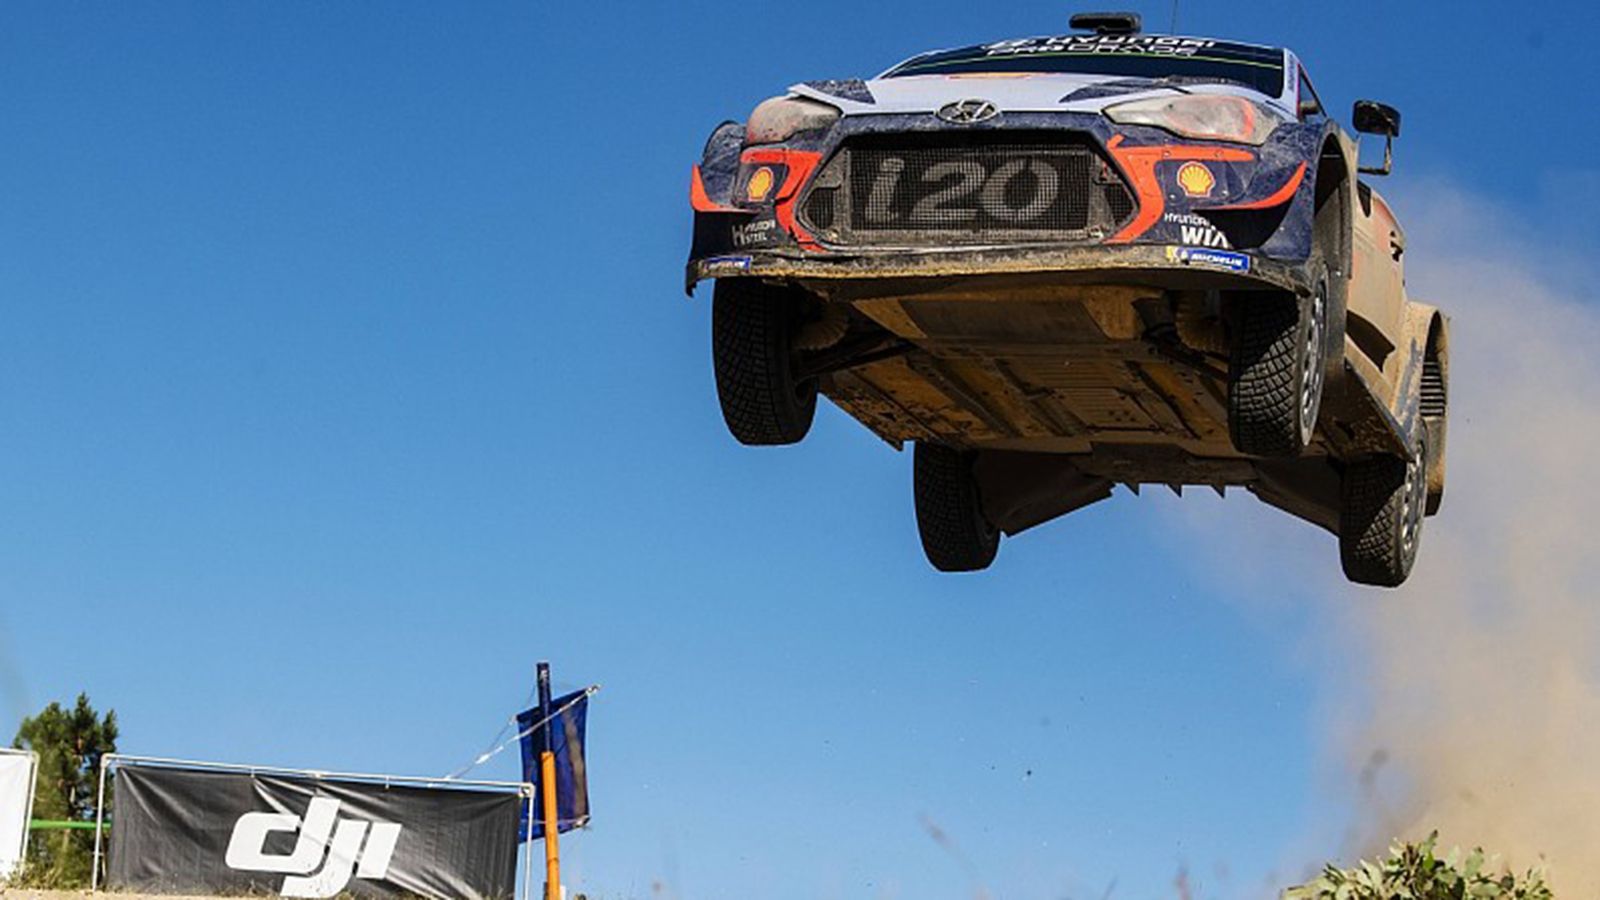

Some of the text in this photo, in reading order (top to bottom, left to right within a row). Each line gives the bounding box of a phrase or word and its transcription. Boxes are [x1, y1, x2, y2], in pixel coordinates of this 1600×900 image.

[1046, 35, 1215, 48] HYUNDAI
[865, 158, 1058, 221] i20
[1181, 225, 1229, 249] WIA
